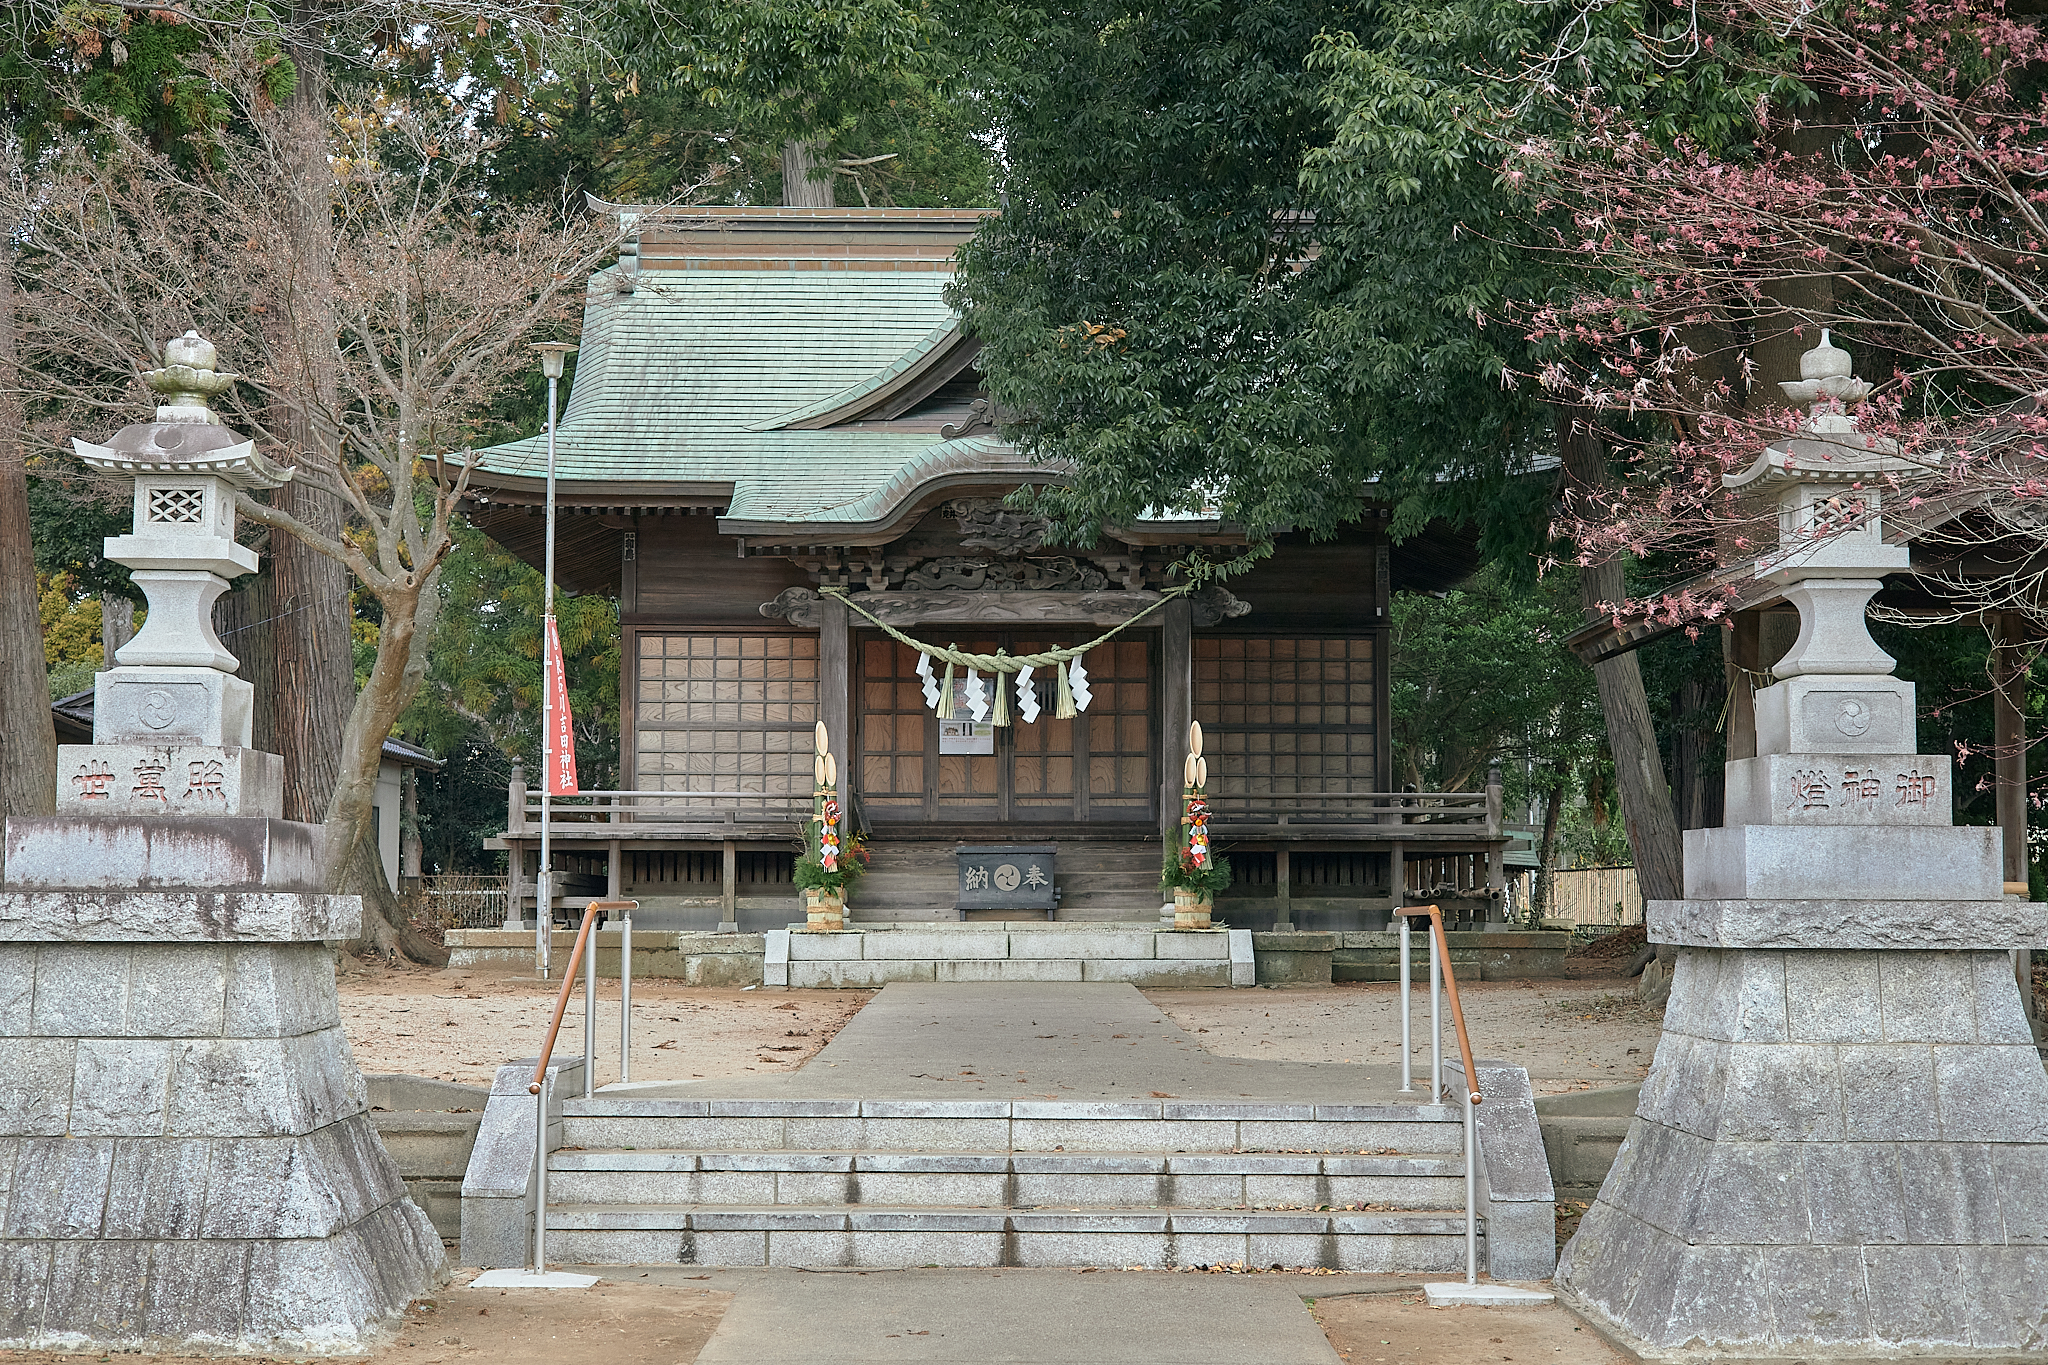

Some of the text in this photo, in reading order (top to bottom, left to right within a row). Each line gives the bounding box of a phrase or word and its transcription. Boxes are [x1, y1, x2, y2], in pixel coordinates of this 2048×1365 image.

[71, 759, 226, 802] 照萬世
[1786, 769, 1936, 812] 御神燈
[965, 864, 1049, 891] 奉納
